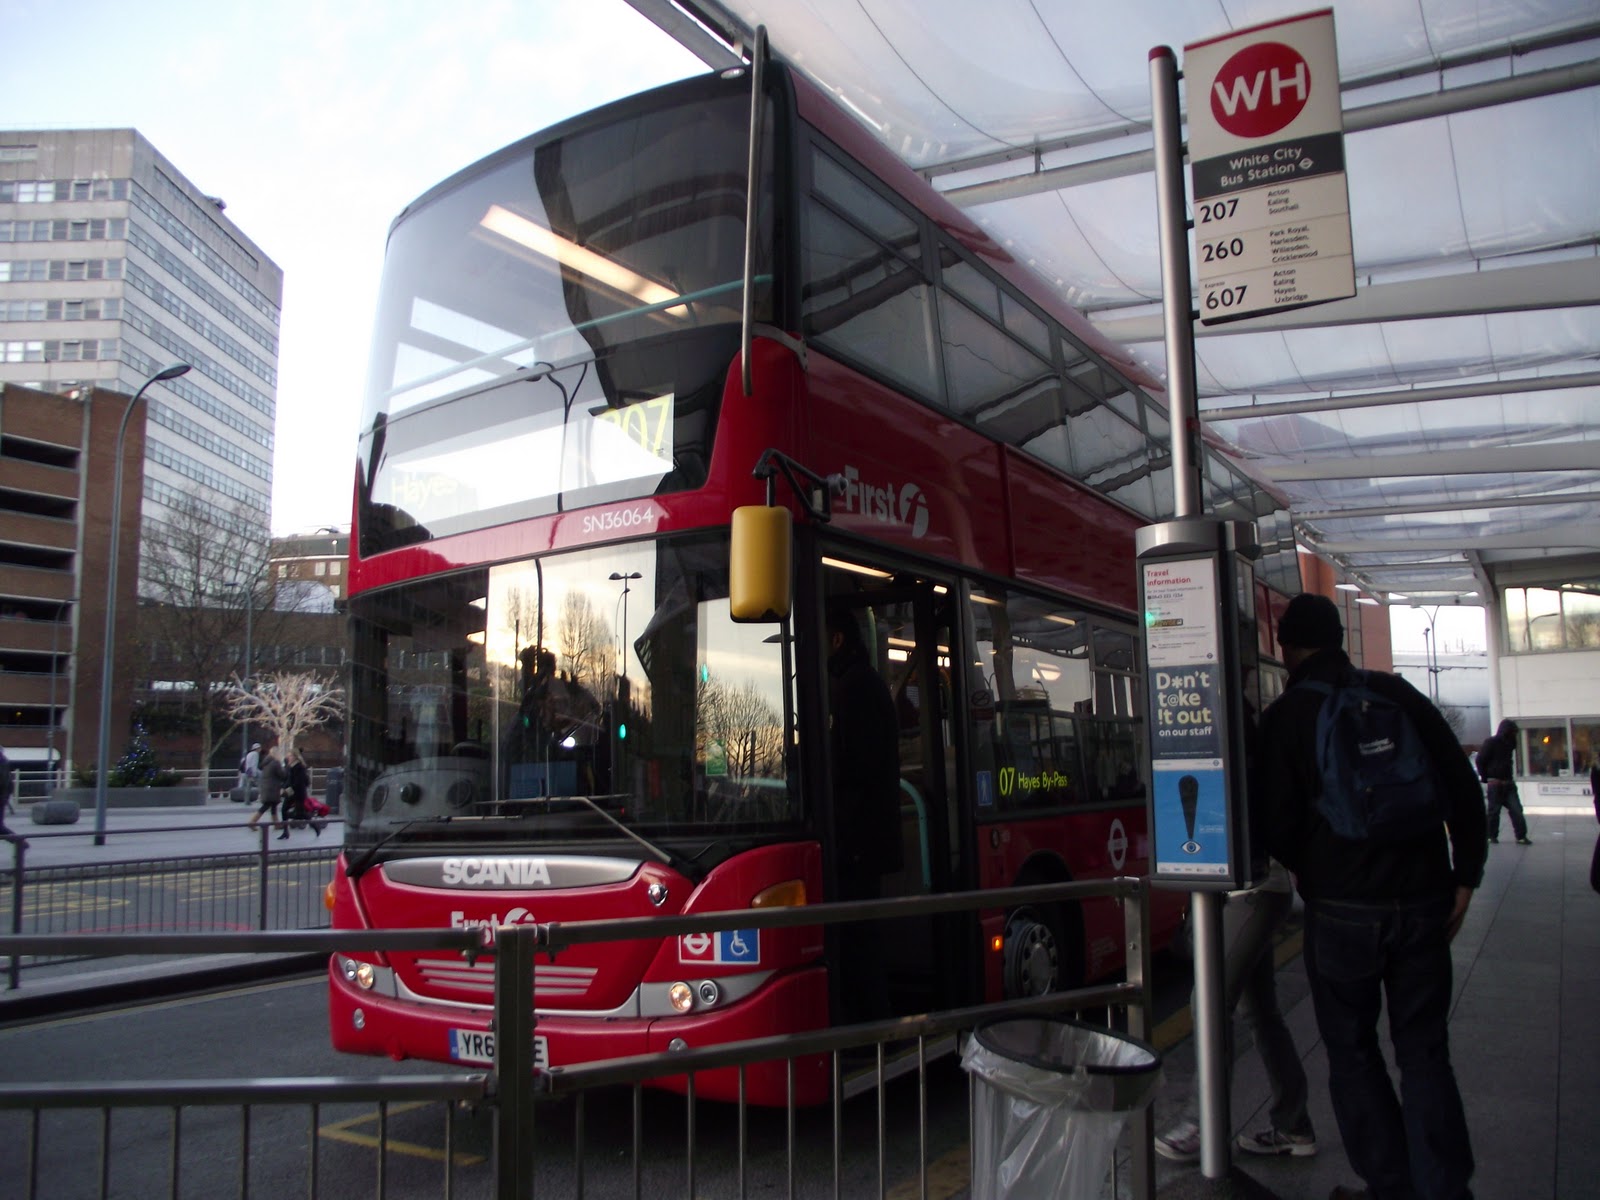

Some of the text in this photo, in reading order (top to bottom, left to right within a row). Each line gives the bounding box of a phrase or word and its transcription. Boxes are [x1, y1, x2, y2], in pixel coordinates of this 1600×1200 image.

[1214, 62, 1307, 116] WH
[1229, 147, 1302, 170] White City
[1220, 163, 1295, 187] Bus Station
[1268, 188, 1290, 197] Acton
[1268, 197, 1290, 206] Ealing
[1268, 204, 1299, 214] Southall
[1200, 198, 1239, 223] 207
[1269, 229, 1285, 237] Park
[1202, 238, 1244, 263] 260
[1272, 250, 1318, 263] Cricklewood
[1273, 269, 1296, 277] Acton
[1273, 277, 1296, 286] Ealing
[1206, 285, 1248, 310] 607
[1274, 286, 1297, 295] Hayes
[1274, 293, 1308, 304] Uxbridge
[845, 464, 897, 525] First
[582, 506, 654, 533] SN36064
[1146, 569, 1169, 577] Travel
[1146, 577, 1191, 586] information
[1157, 689, 1201, 707] t@ke
[1176, 707, 1212, 724] out
[1158, 726, 1213, 737] on our staff
[1018, 772, 1041, 793] Hayes
[1042, 771, 1068, 792] By-Pass
[442, 858, 551, 885] SCANIA
